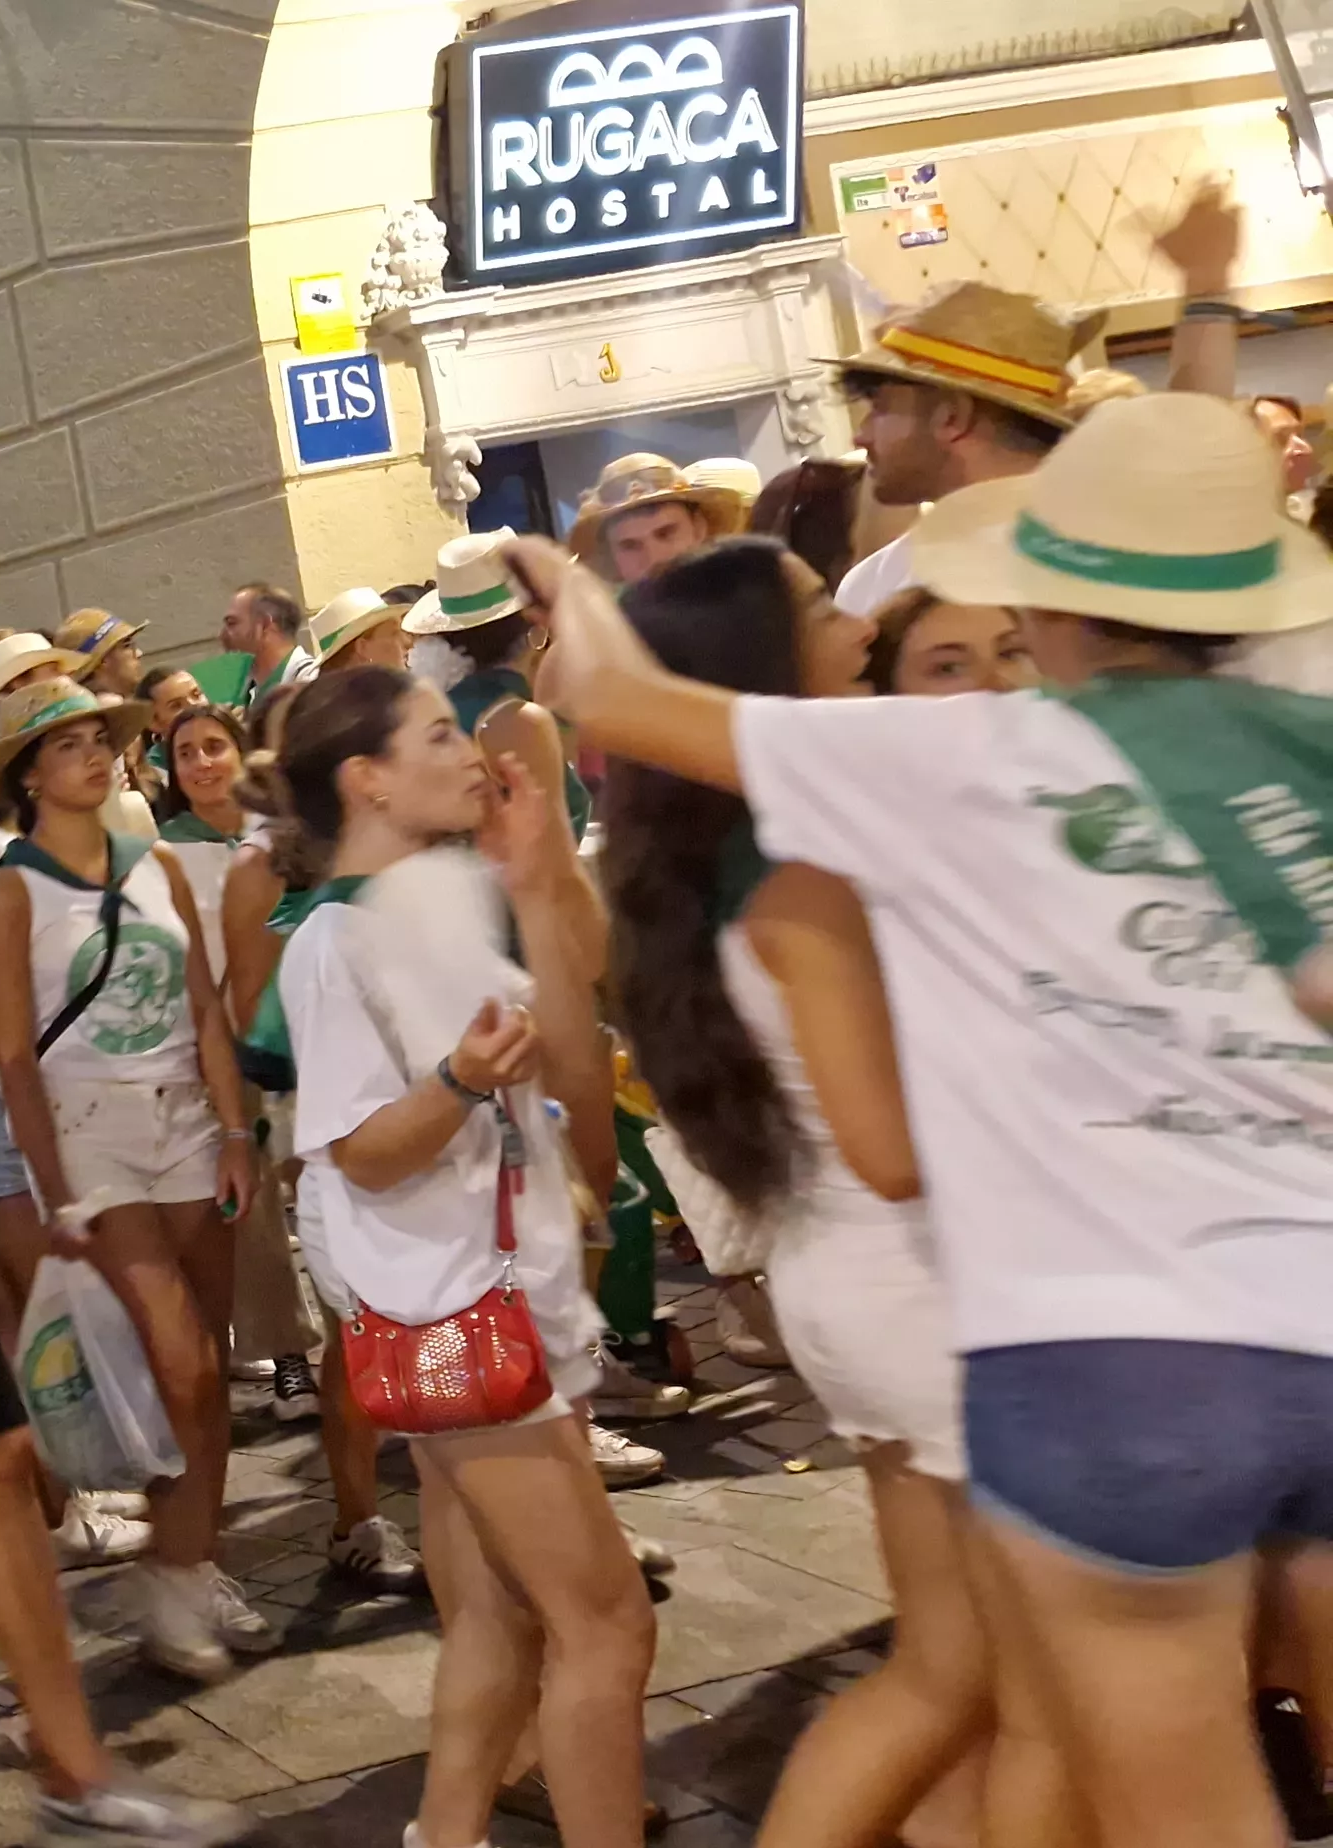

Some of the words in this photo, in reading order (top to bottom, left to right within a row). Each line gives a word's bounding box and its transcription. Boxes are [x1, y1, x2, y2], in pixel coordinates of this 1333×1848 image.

[491, 87, 781, 191] RUGACA
[492, 168, 778, 243] HOSTAL
[297, 364, 376, 425] HS
